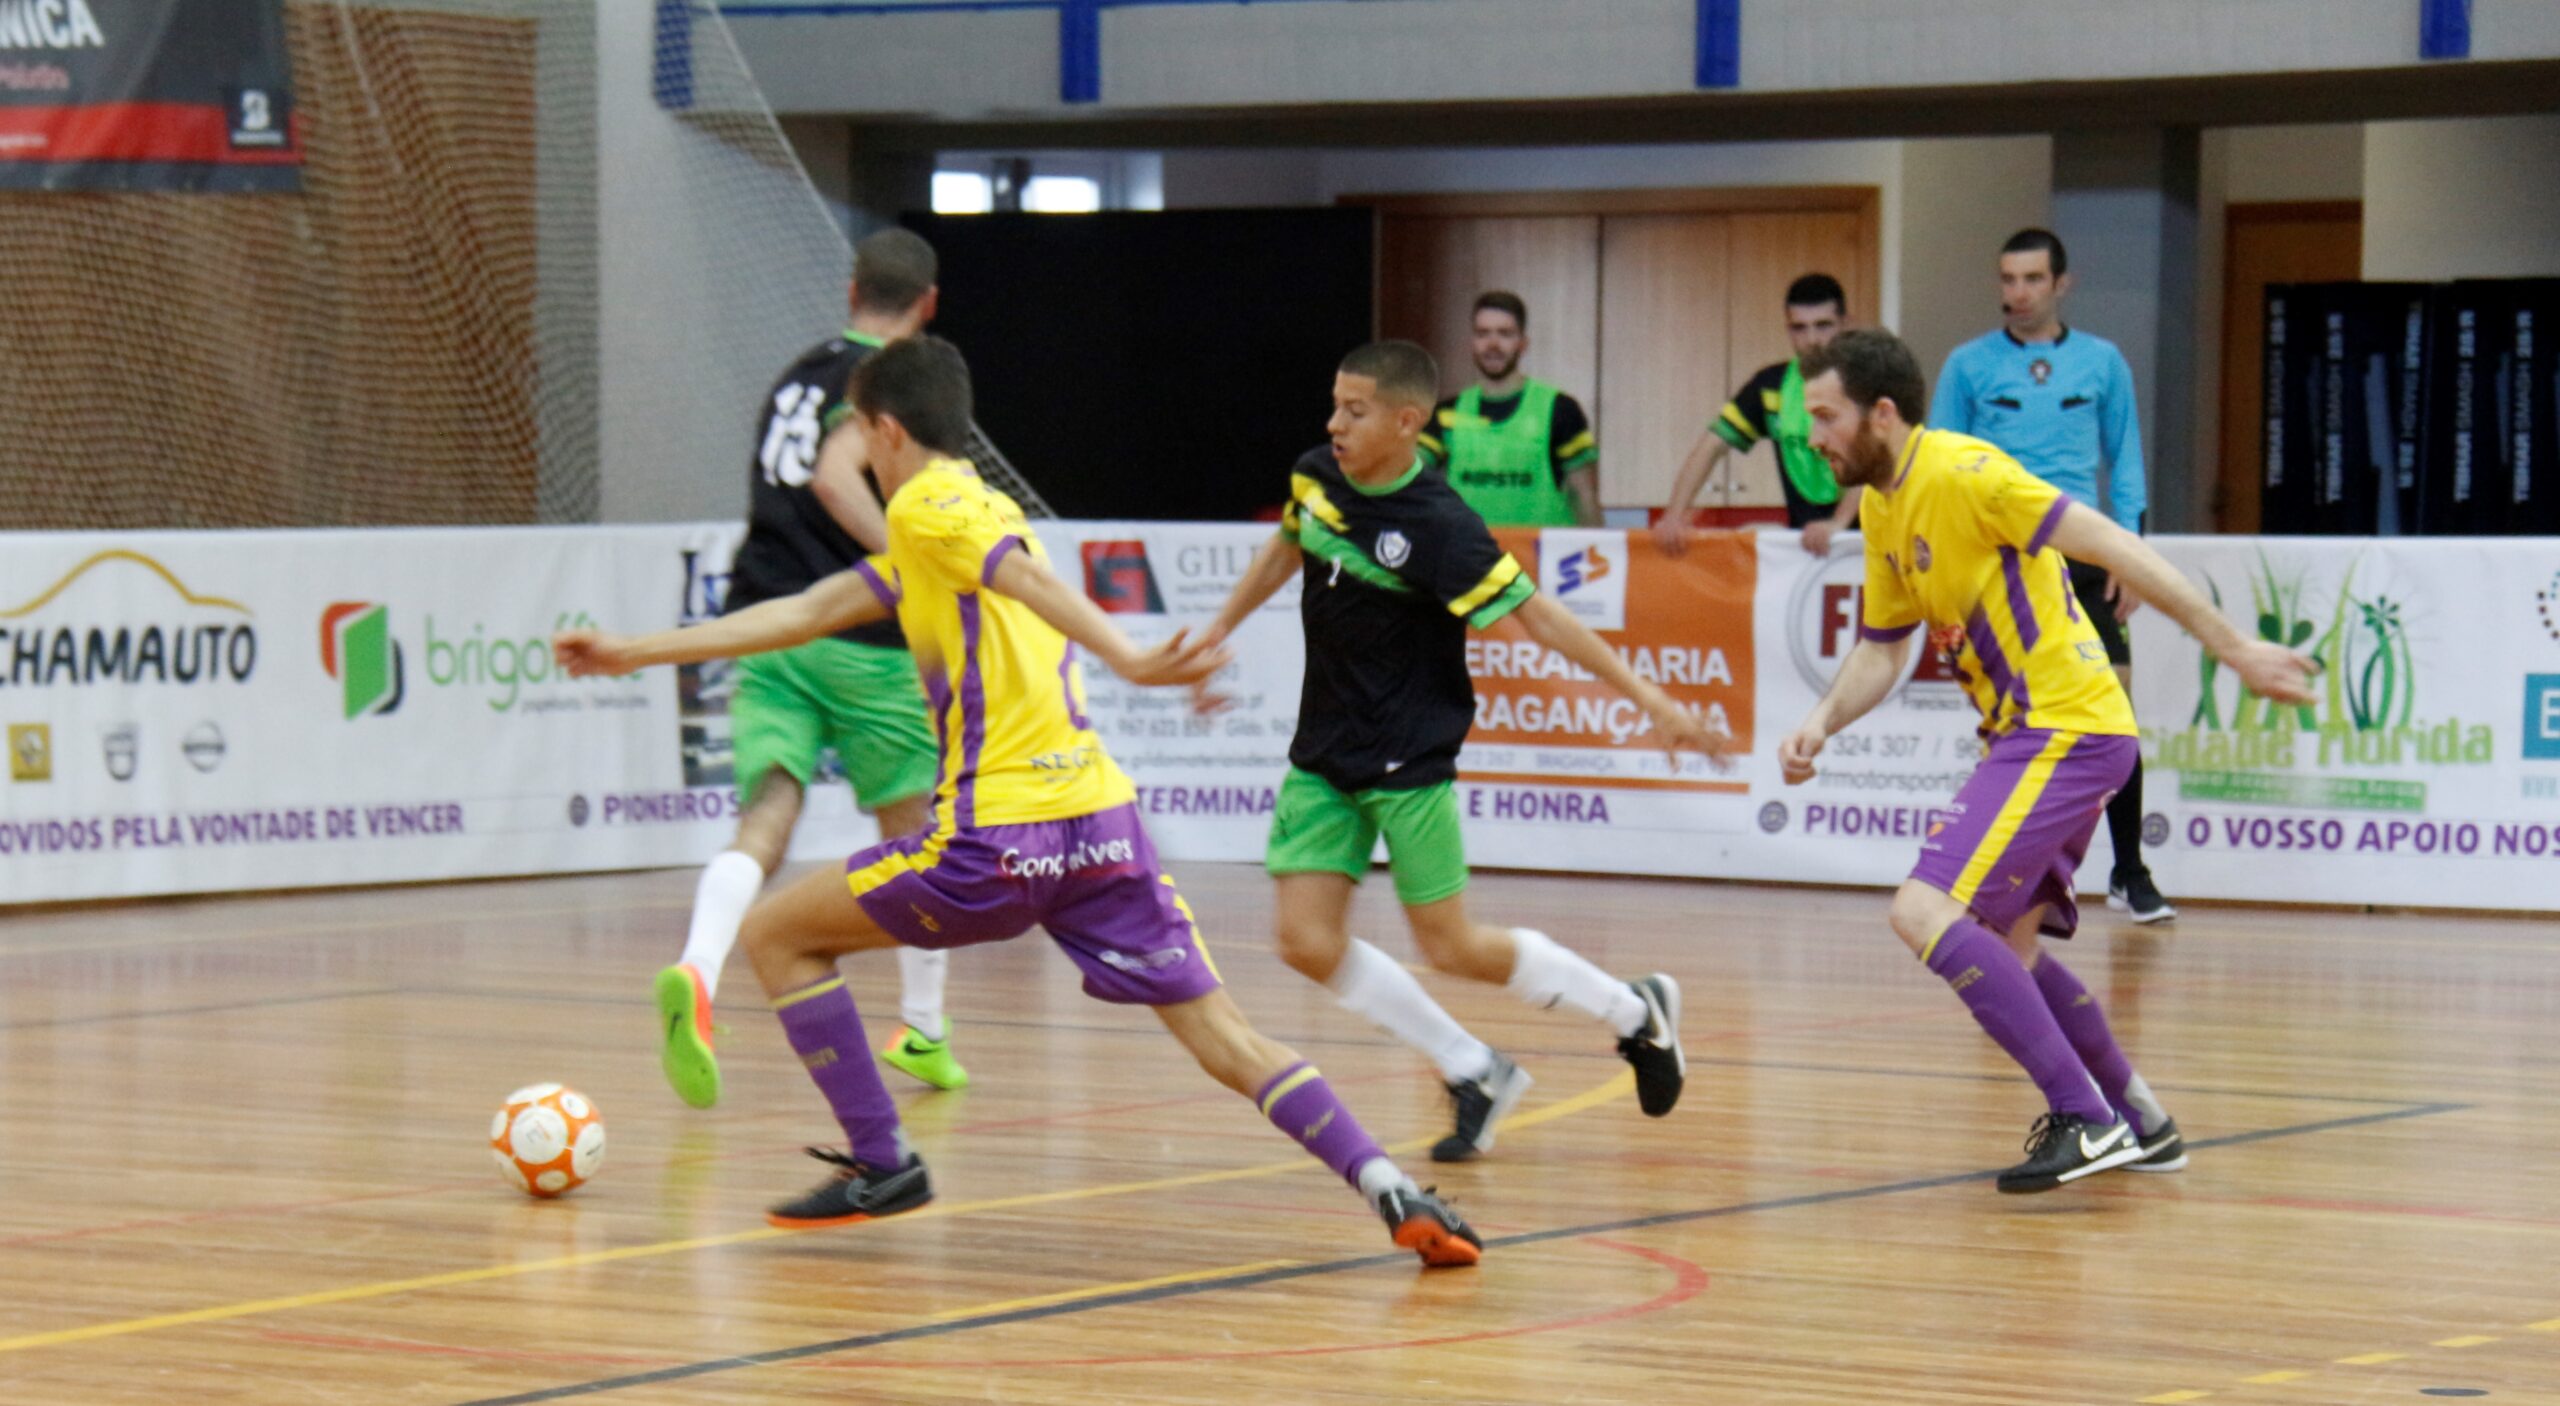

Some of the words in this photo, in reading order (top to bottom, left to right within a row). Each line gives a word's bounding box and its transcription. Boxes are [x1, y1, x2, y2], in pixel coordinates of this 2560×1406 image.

[425, 612, 645, 713] brigo
[112, 815, 183, 849] PELA
[190, 808, 316, 844] VONTADE
[326, 808, 357, 839] DE
[366, 804, 465, 837] VENCER
[1468, 788, 1483, 819] E
[1493, 790, 1610, 824] HONRA
[2187, 816, 2212, 848] O
[2224, 818, 2345, 851] VOSSO
[2356, 821, 2481, 855] APOIO
